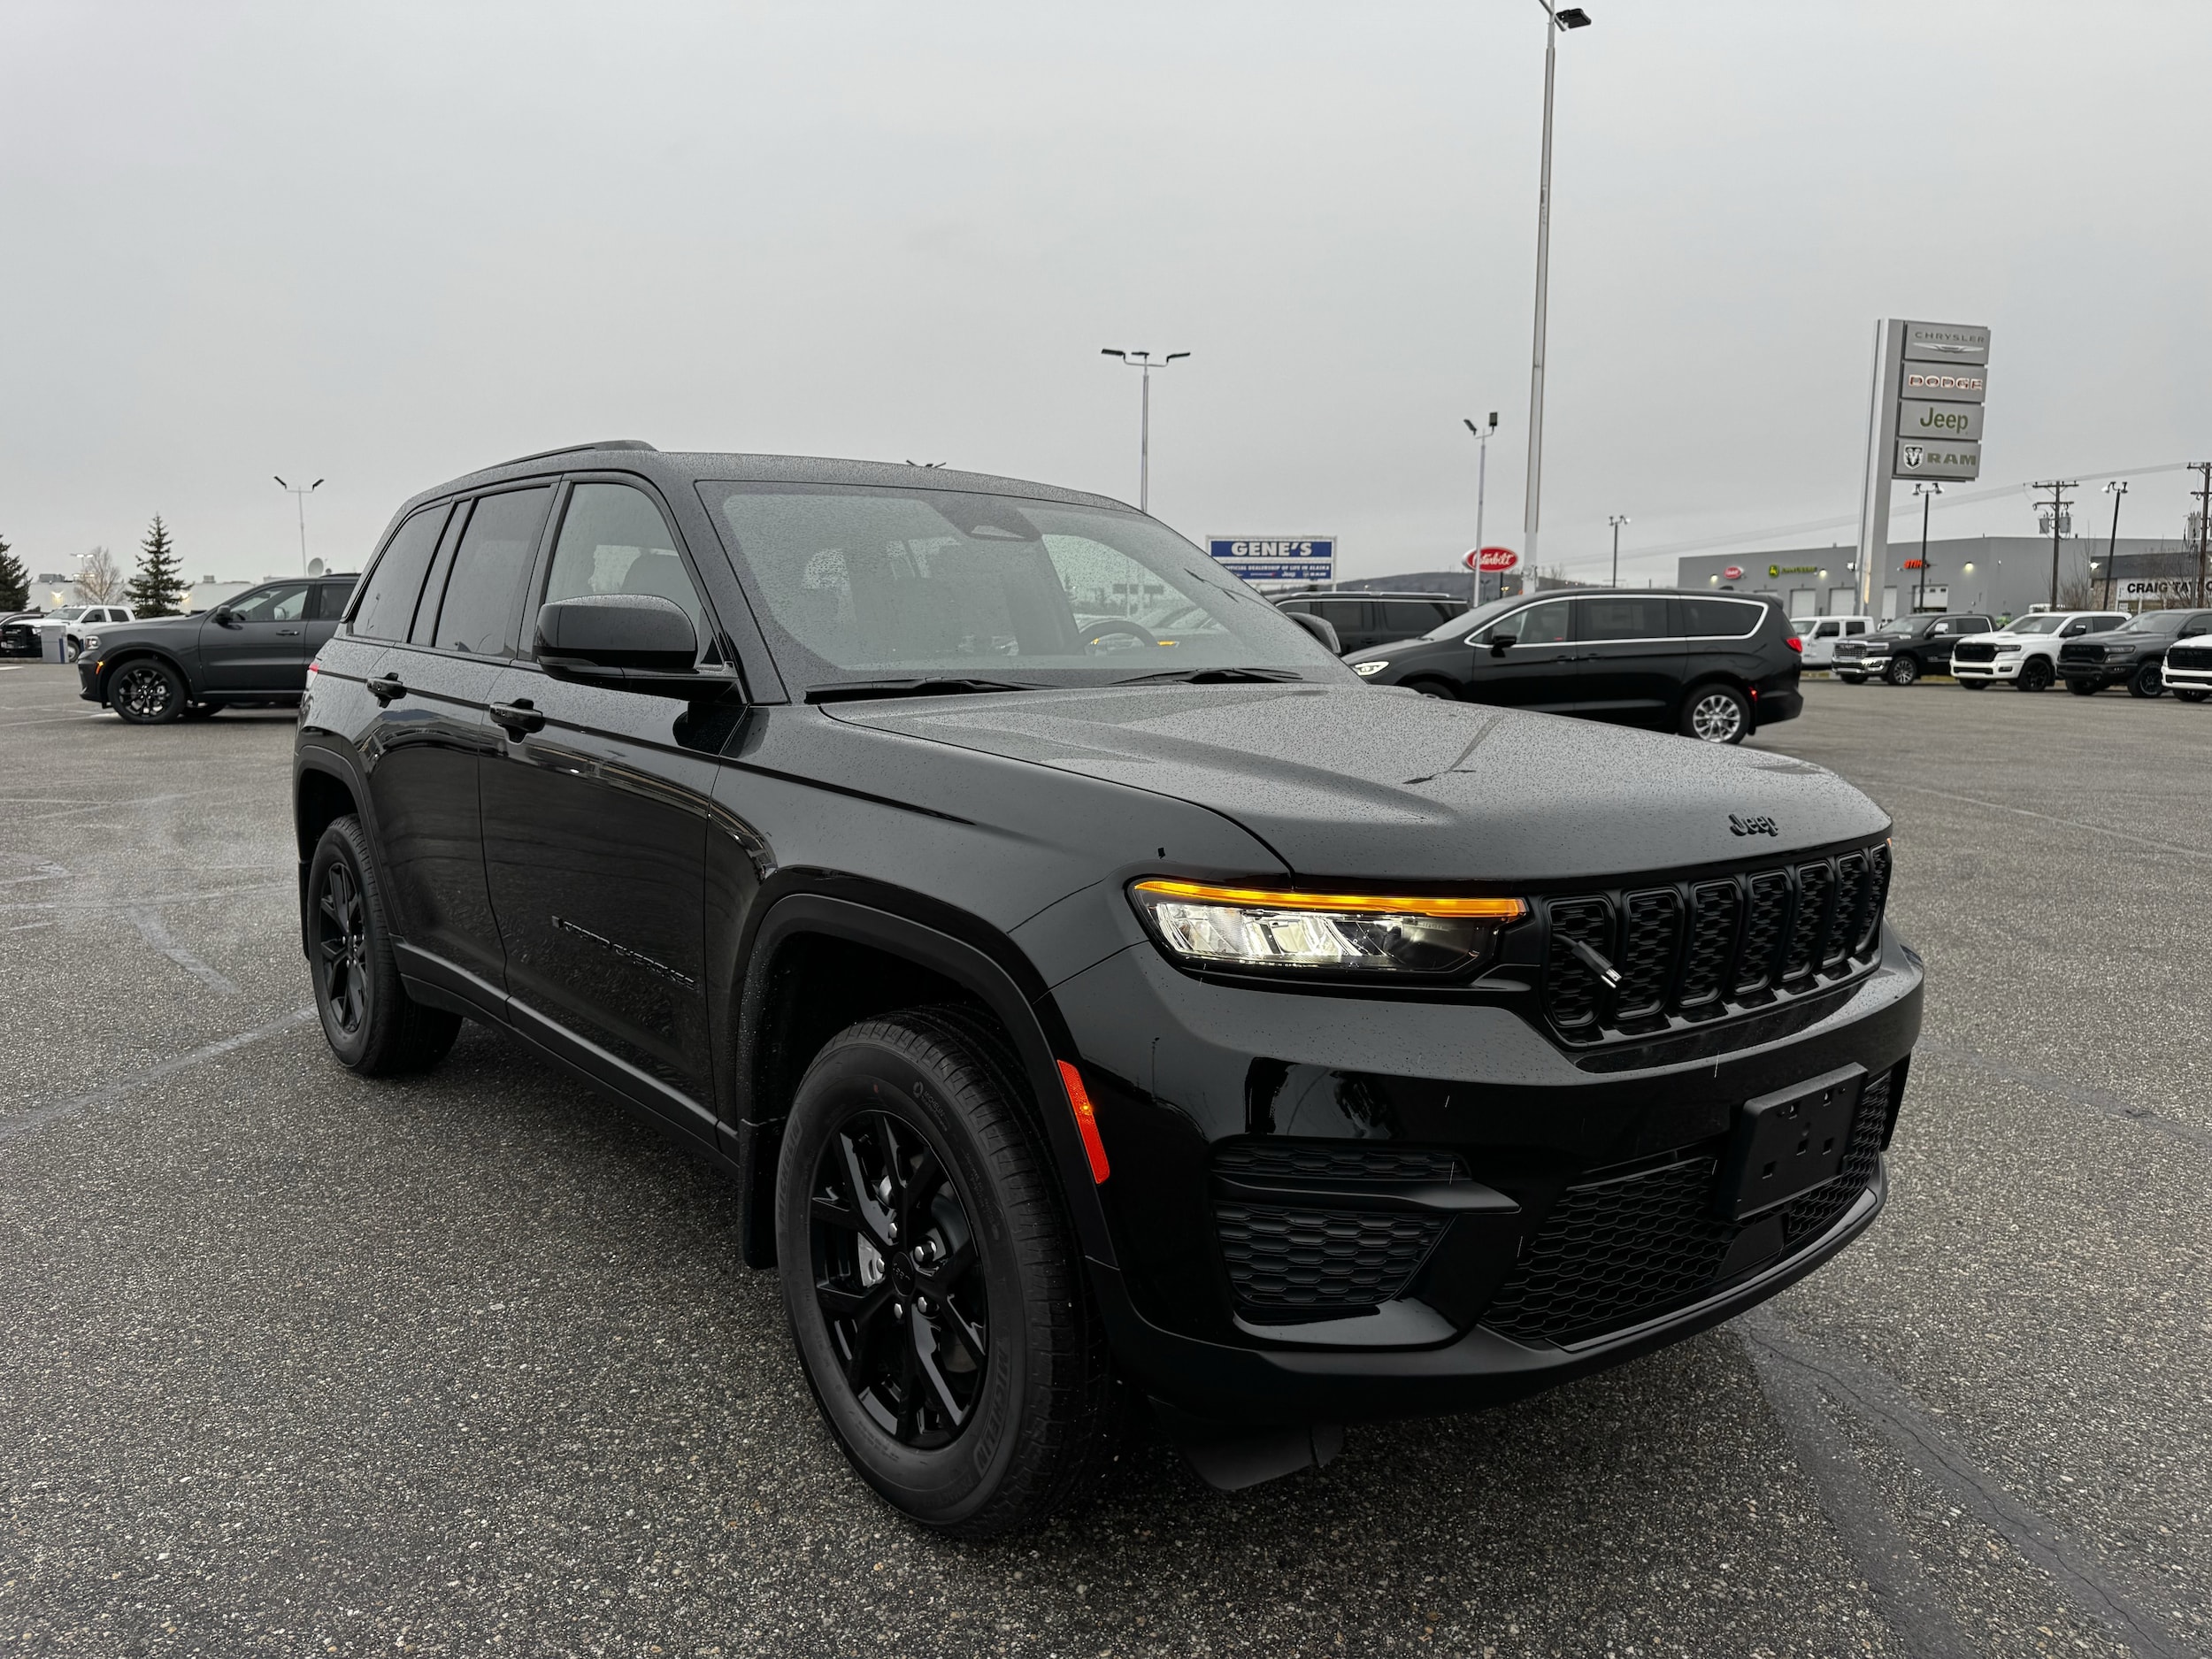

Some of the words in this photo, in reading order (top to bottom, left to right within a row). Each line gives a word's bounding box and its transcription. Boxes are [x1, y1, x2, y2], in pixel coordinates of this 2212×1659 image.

[1915, 331, 1985, 343] CHRYSLER
[1909, 374, 1984, 391] DODGE
[1919, 407, 1969, 434] Jeep
[1927, 452, 1977, 466] RAM
[1231, 541, 1313, 557] GENE'S
[1903, 559, 1925, 569] STIH
[2127, 583, 2168, 594] CRAIG
[1728, 814, 1778, 836] Jeep
[975, 1346, 1010, 1471] MICHELIN
